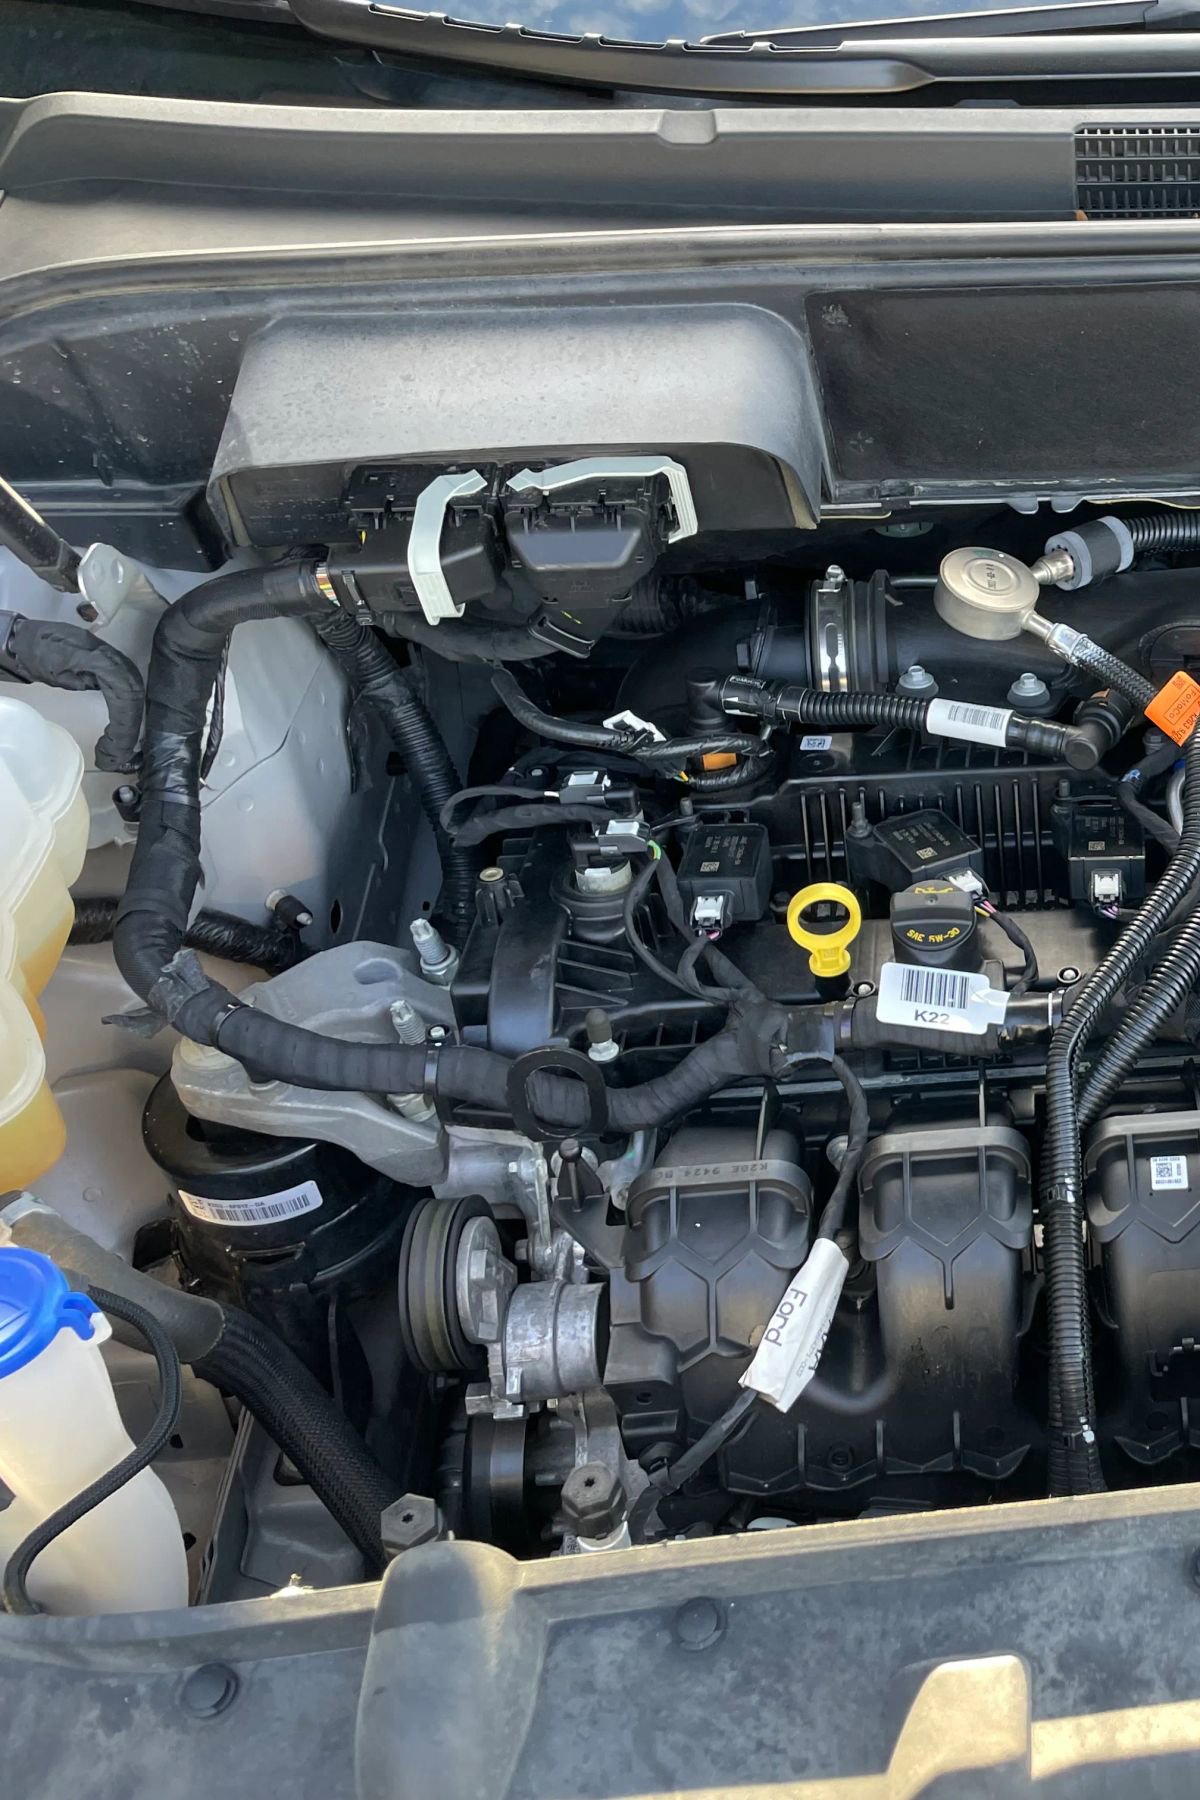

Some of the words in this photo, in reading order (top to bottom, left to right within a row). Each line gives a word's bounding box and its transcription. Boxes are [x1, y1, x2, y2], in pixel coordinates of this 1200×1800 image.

[907, 928, 925, 943] SAE
[928, 927, 961, 943] 5W-30
[914, 1009, 951, 1026] K22
[764, 1287, 808, 1347] Ford
